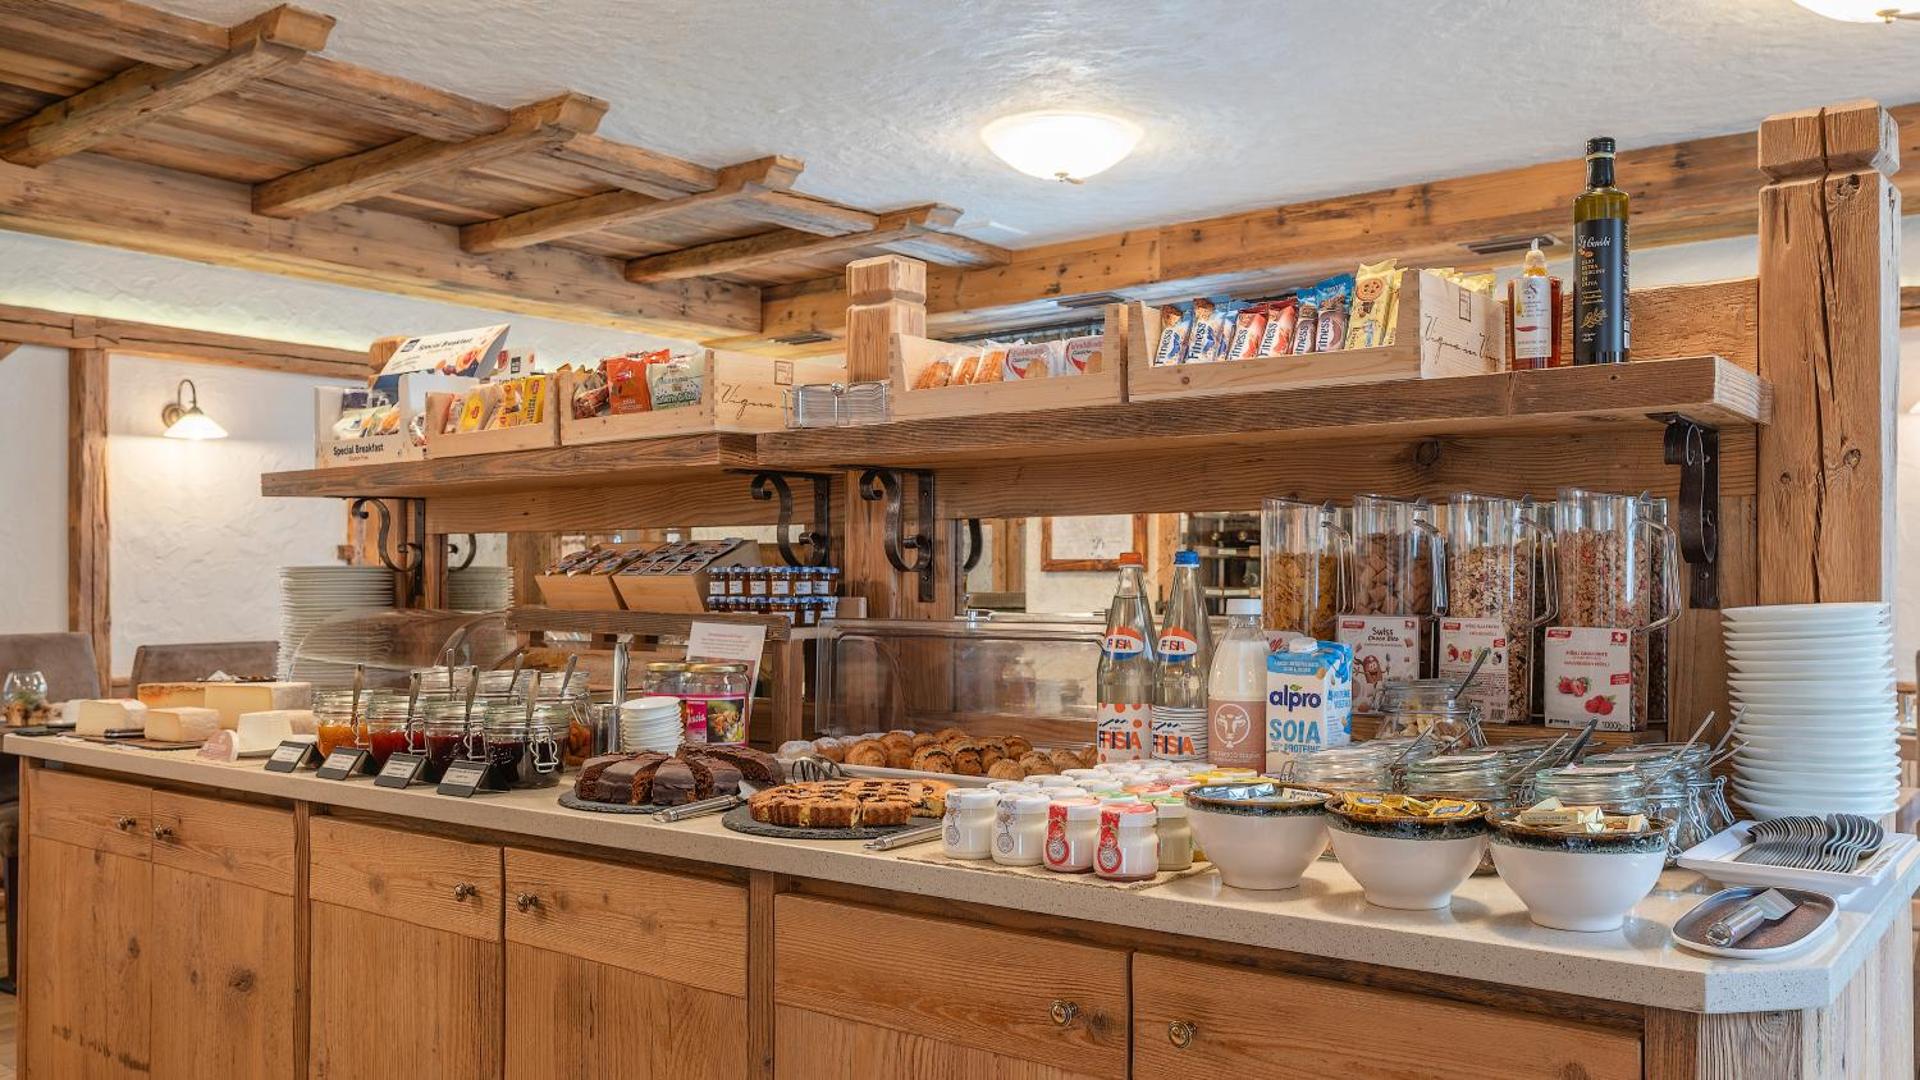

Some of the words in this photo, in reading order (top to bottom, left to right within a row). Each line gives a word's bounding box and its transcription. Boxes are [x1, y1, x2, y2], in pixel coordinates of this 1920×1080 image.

[1154, 329, 1174, 364] Fitness
[1187, 321, 1206, 359] Fitness
[1260, 322, 1278, 357] Fitness
[1296, 325, 1309, 355] itness
[333, 444, 354, 456] Special
[355, 442, 384, 454] Breakfast
[1106, 638, 1133, 650] FISIA
[1160, 639, 1187, 651] FISIA
[1371, 626, 1394, 637] Swiss
[1269, 684, 1322, 712] alpro
[1269, 718, 1322, 744] SOIA
